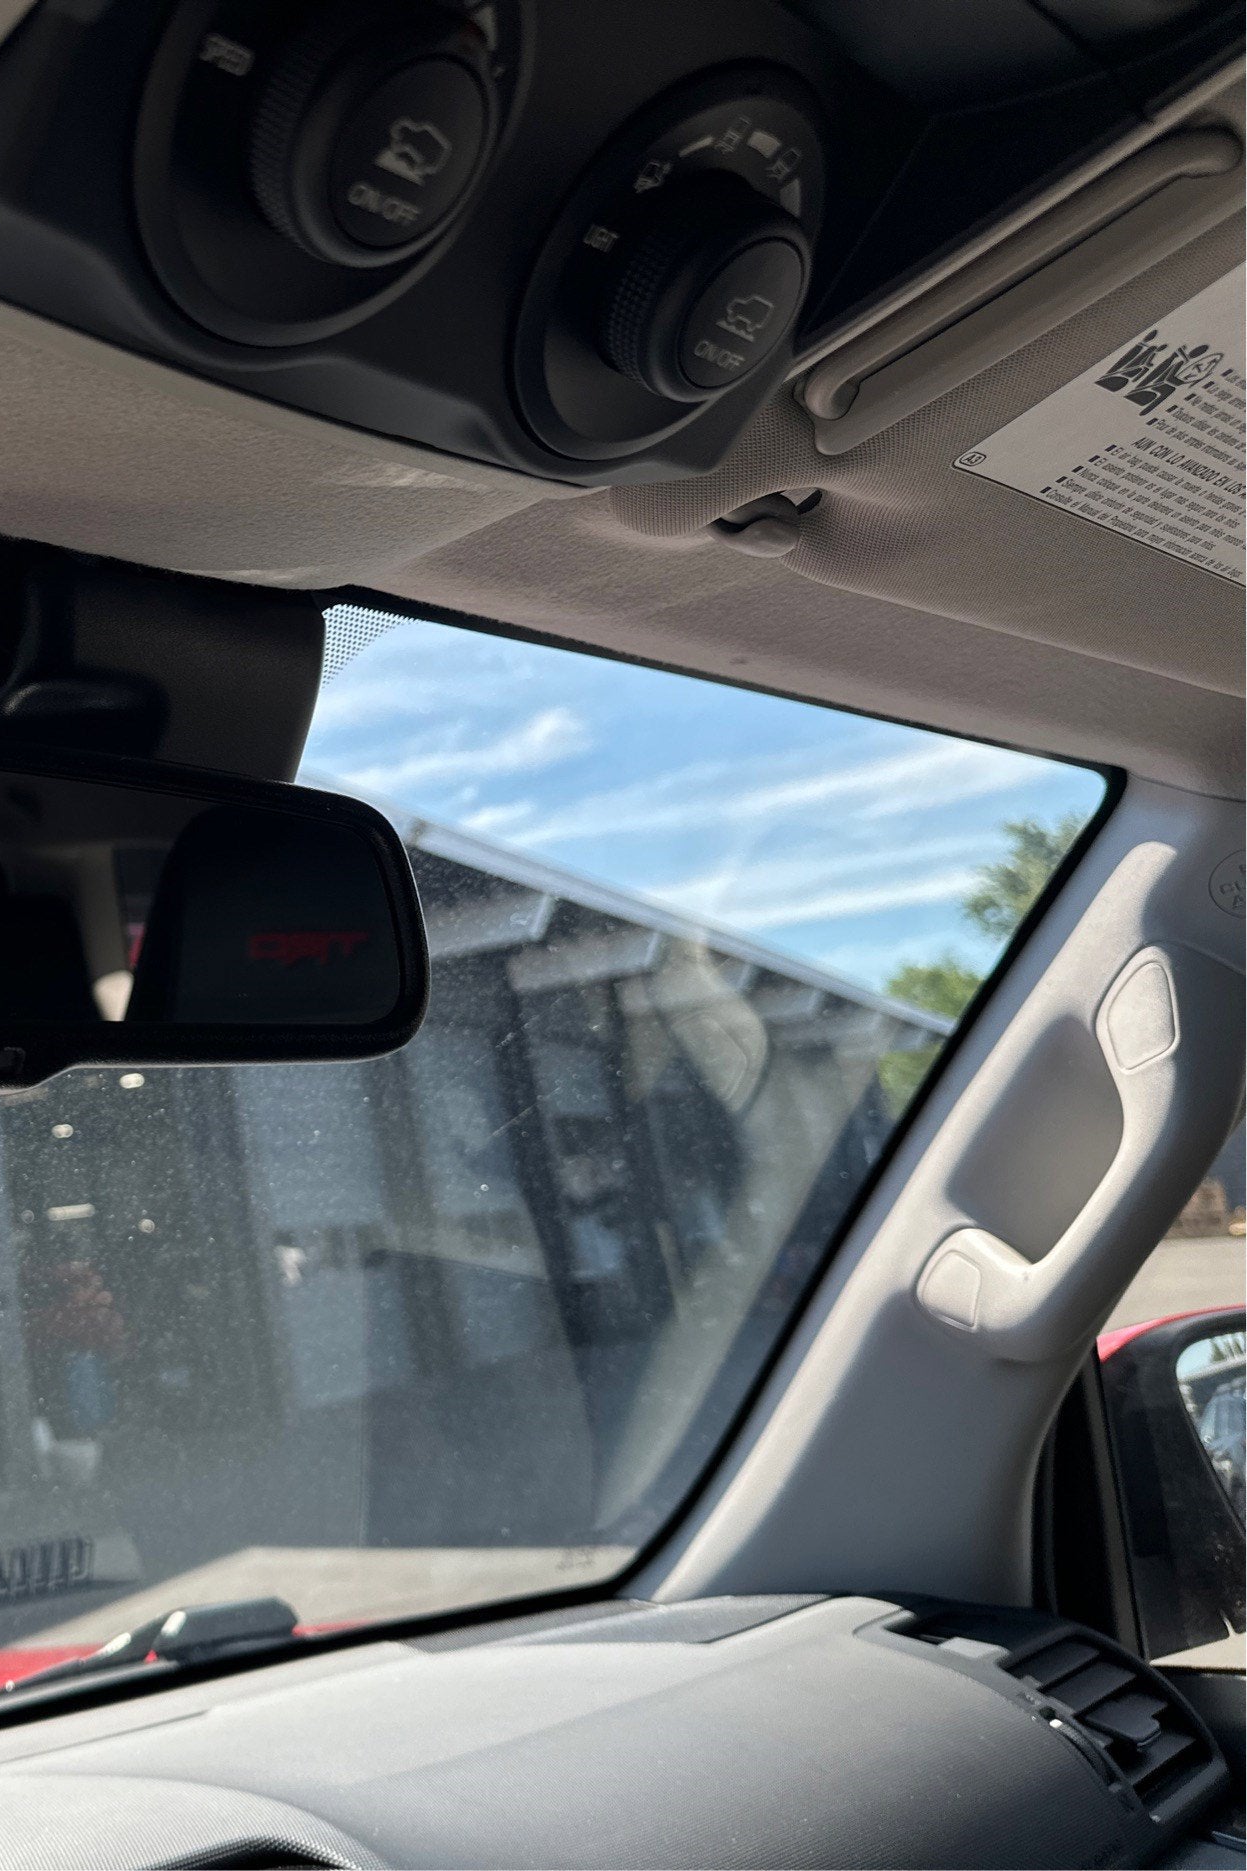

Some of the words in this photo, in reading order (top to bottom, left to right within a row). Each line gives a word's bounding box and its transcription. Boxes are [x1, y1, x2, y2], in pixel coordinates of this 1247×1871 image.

[963, 454, 982, 464] A3
[1149, 445, 1175, 460] CON
[1166, 453, 1186, 465] LO
[1177, 458, 1221, 482] AVANZADO
[1213, 475, 1233, 488] EN
